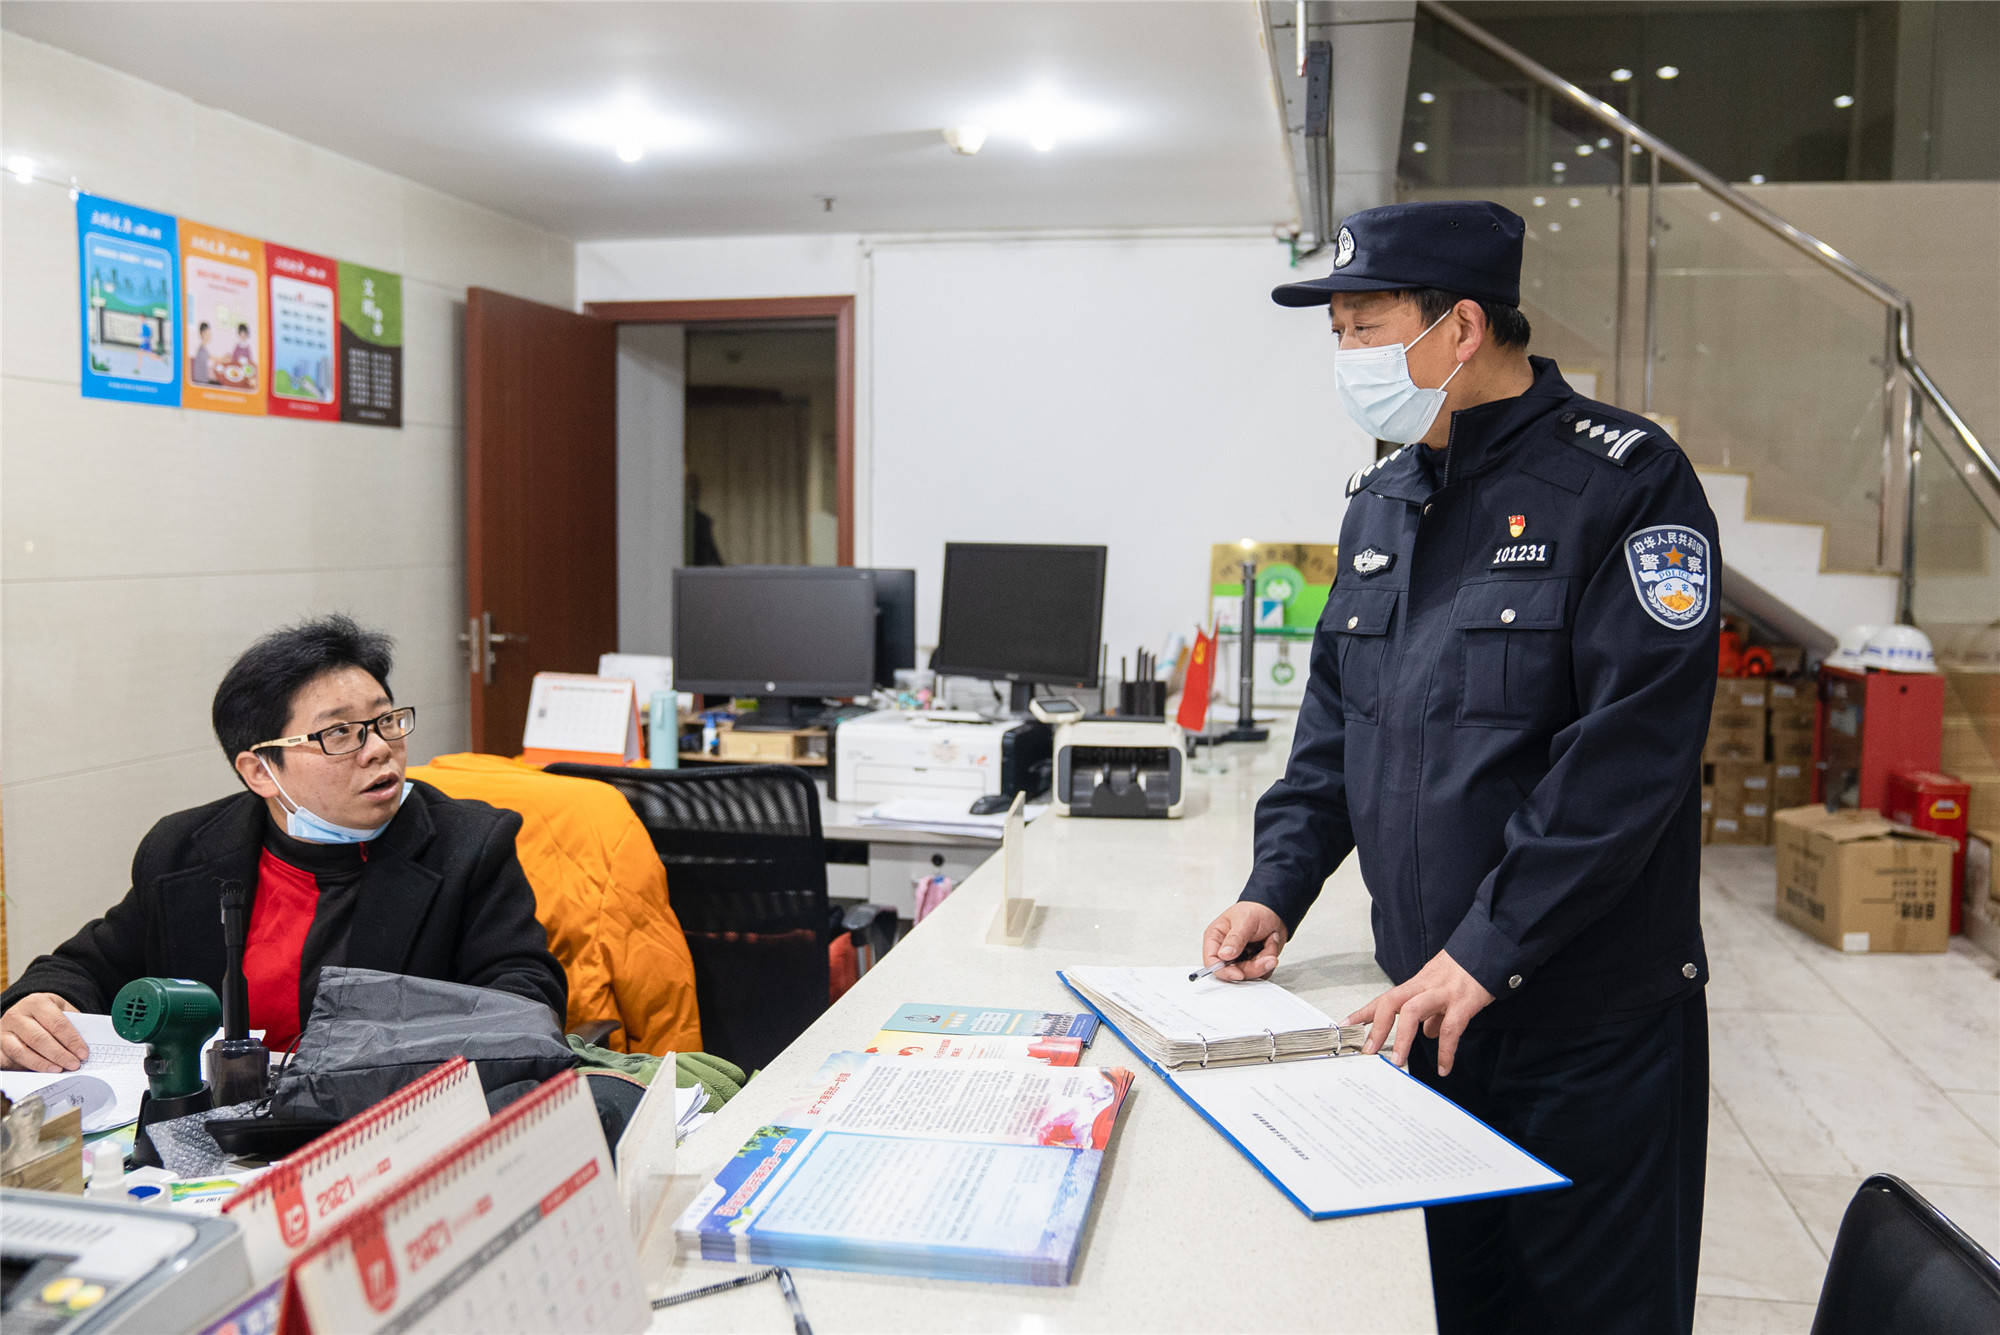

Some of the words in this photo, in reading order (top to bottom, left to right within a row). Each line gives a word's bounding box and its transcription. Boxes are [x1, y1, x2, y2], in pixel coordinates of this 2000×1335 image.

[1493, 544, 1546, 564] 101231
[1633, 532, 1704, 557] 中华人民共和国
[1640, 554, 1660, 570] 警
[1687, 556, 1702, 573] 察
[1658, 569, 1692, 581] POLICE
[1664, 582, 1672, 591] 公
[1681, 583, 1689, 593] 安
[316, 1175, 354, 1218] 2021
[406, 1218, 452, 1272] 2021
